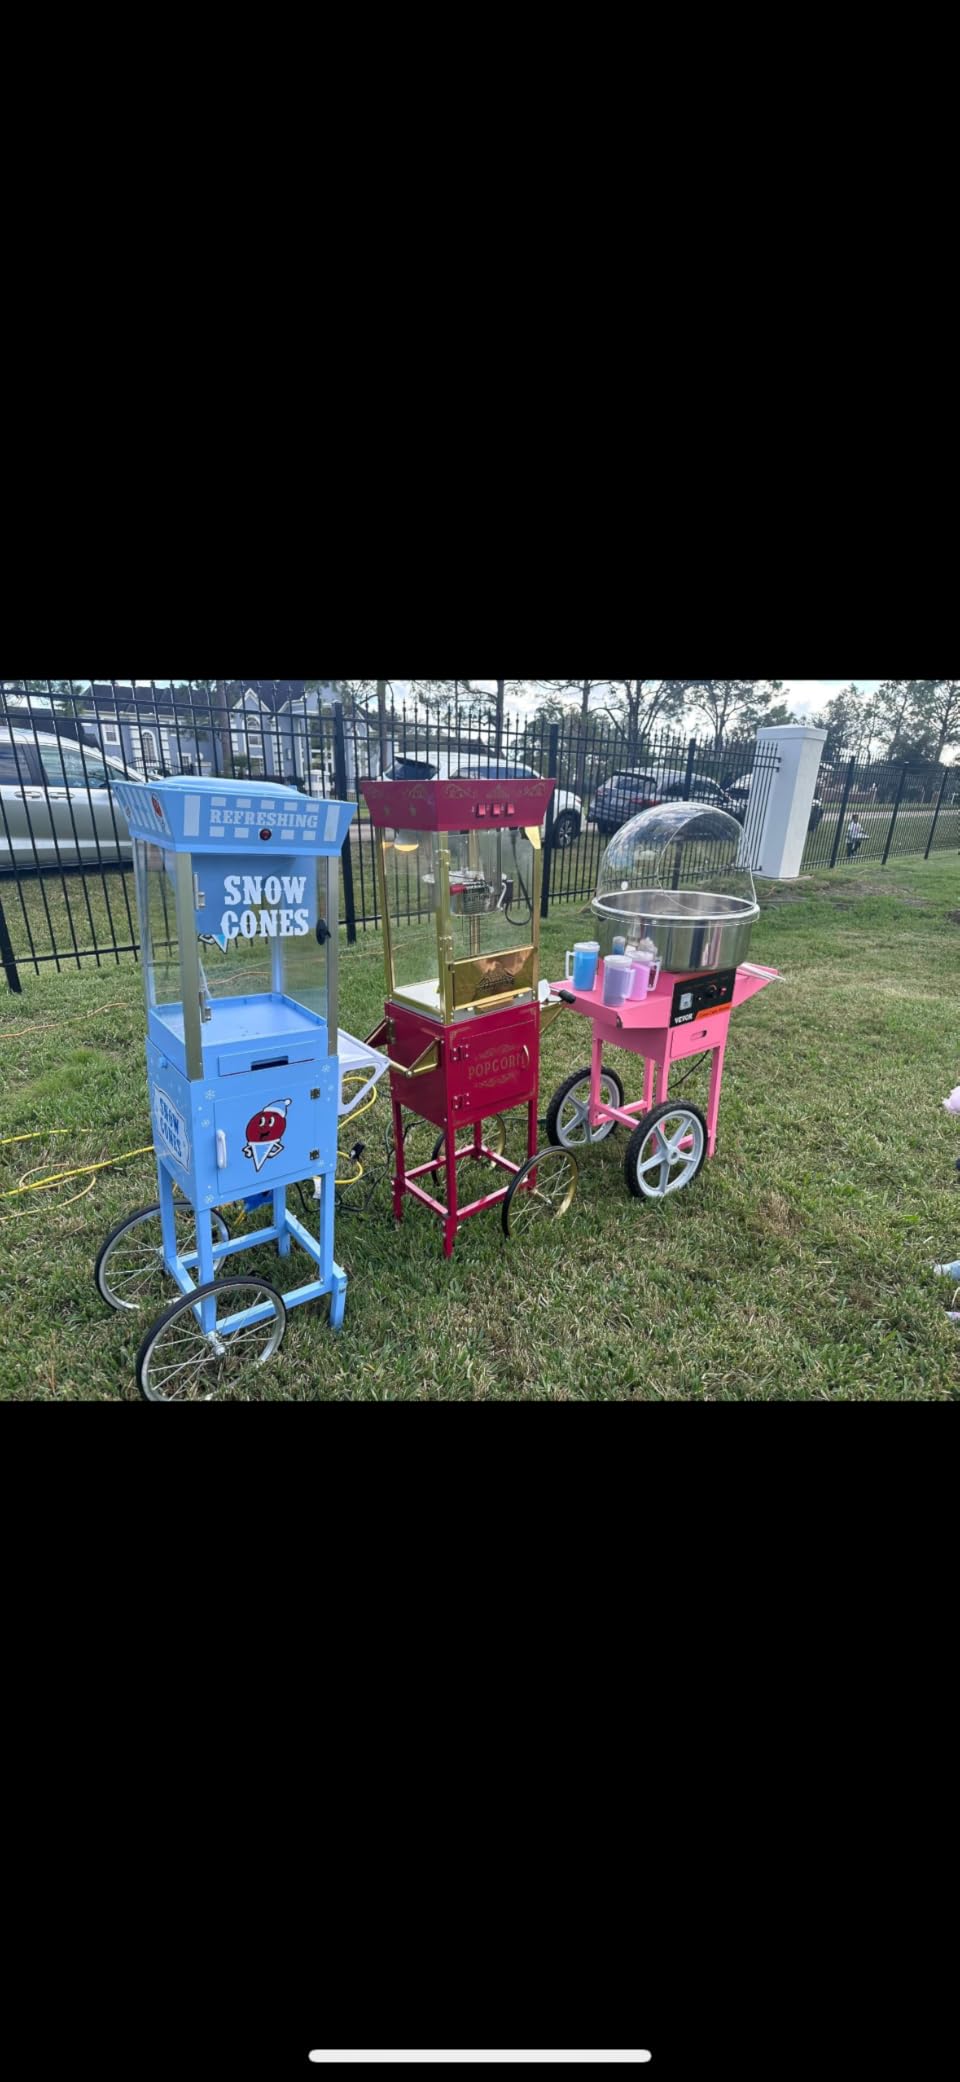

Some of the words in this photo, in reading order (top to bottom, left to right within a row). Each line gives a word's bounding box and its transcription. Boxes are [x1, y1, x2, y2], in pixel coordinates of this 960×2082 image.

[210, 809, 318, 828] REFRESHING
[223, 875, 307, 905] SNOW
[220, 909, 309, 939] CONES
[674, 1013, 693, 1024] VEVOR
[468, 1053, 526, 1080] POPCORN
[159, 1097, 179, 1135] SNOW
